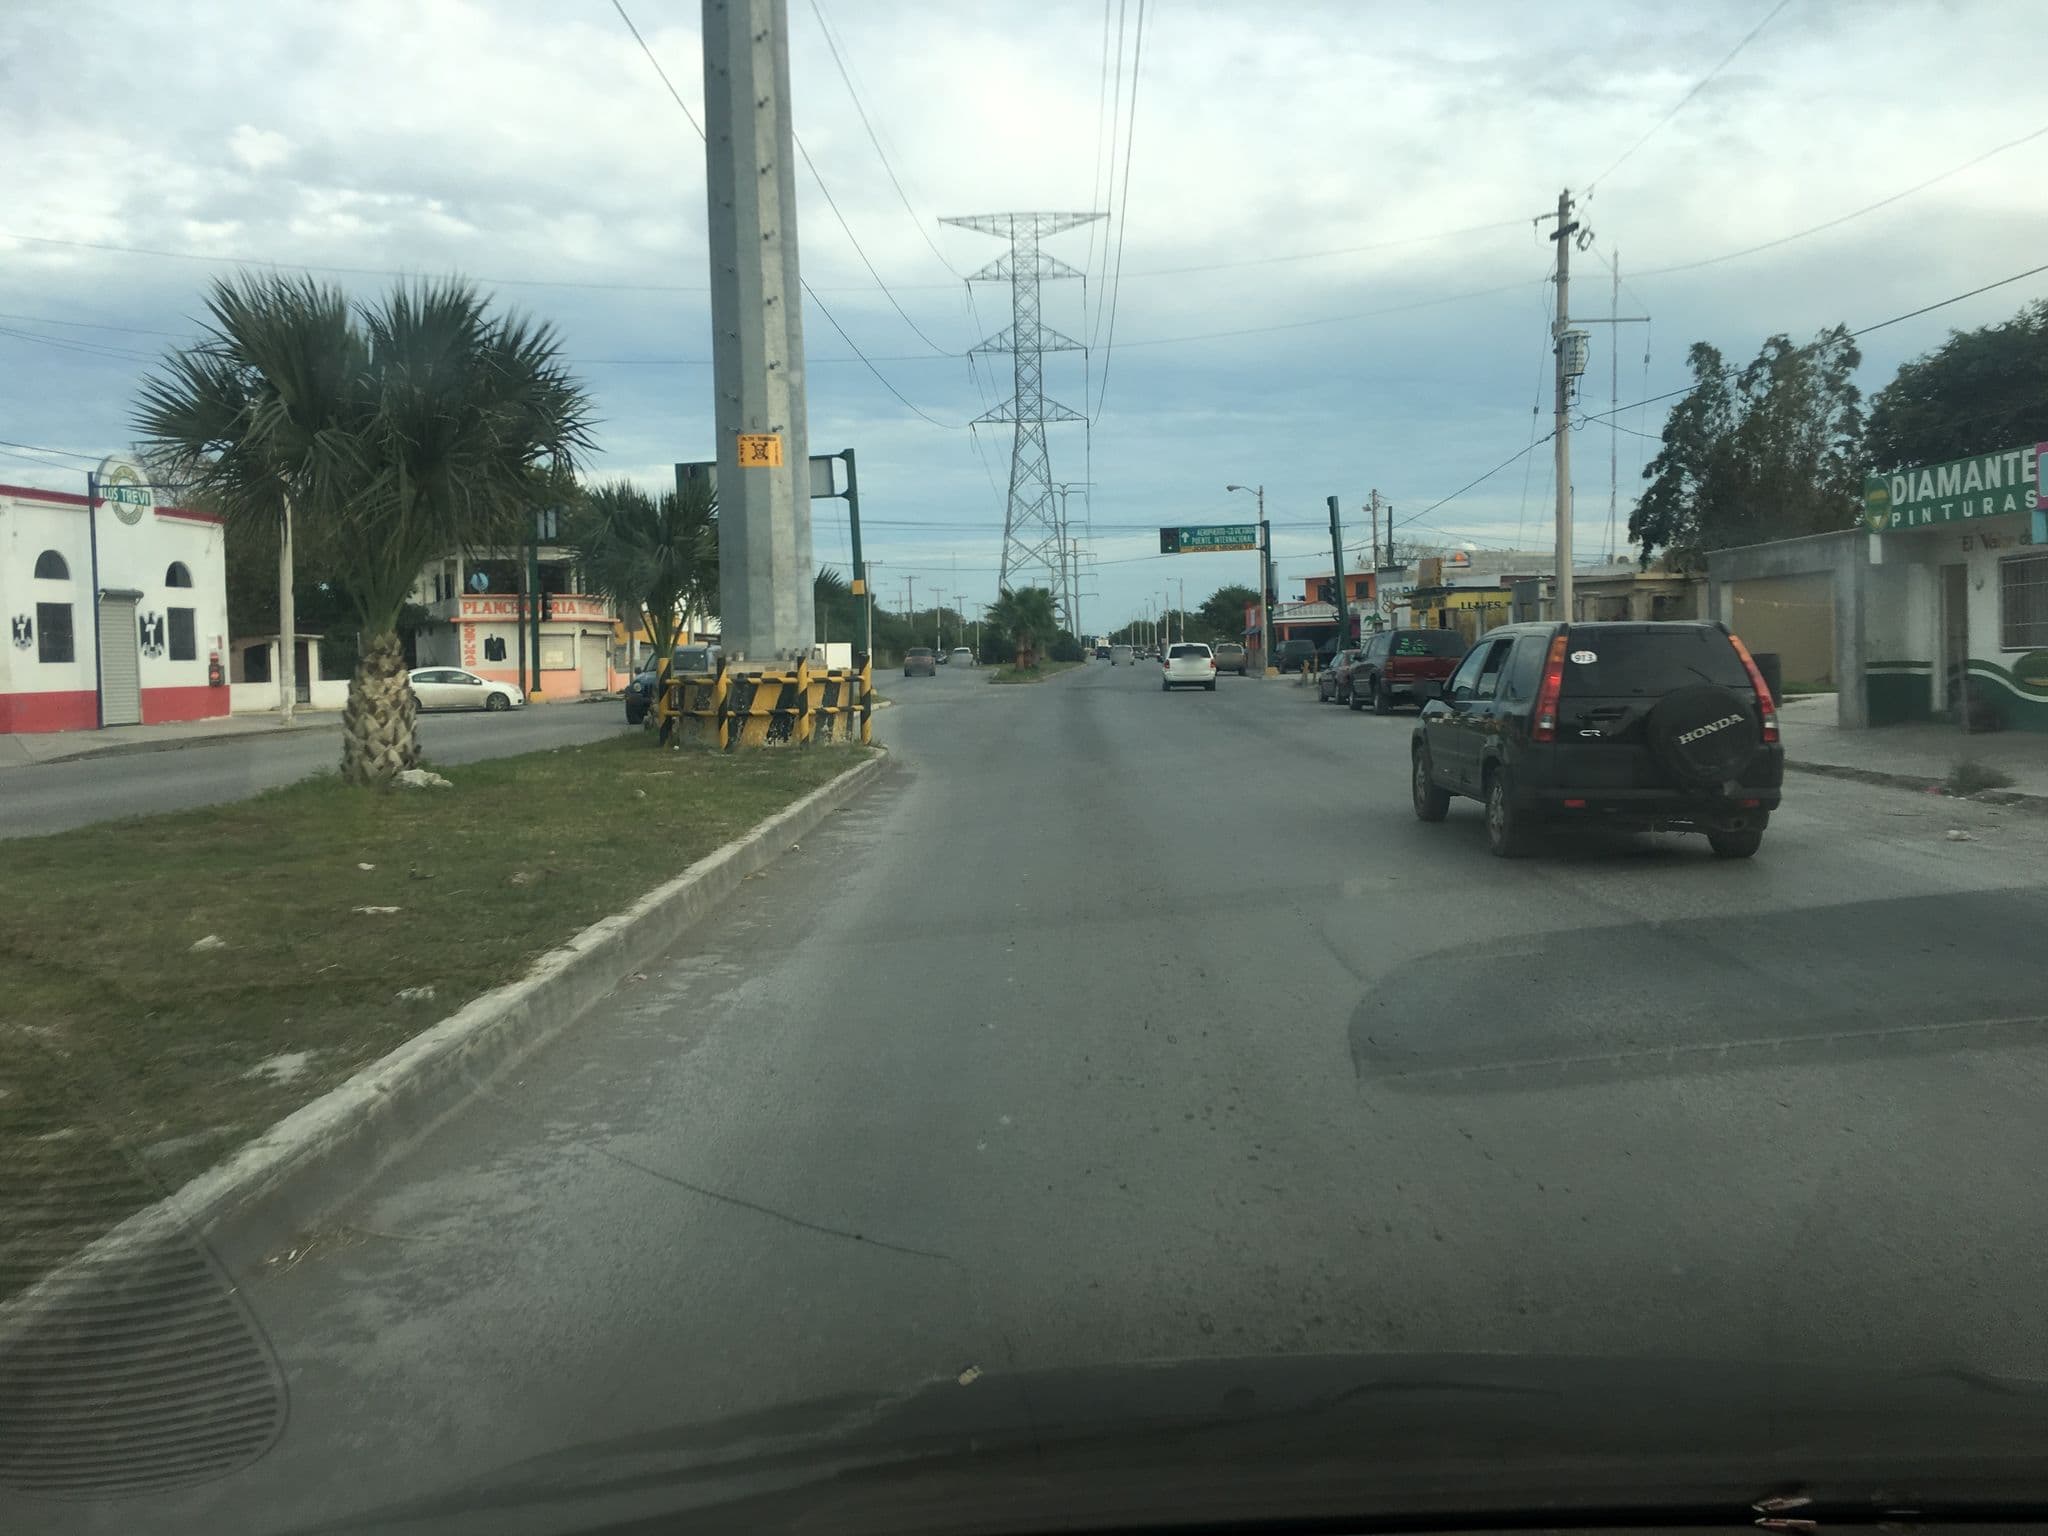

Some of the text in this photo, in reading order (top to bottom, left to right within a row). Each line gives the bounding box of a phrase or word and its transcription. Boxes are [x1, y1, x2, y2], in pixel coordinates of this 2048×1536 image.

[1892, 448, 2037, 506] DIAMANTE
[103, 487, 119, 501] LOS
[1892, 489, 2039, 528] PINTURAS
[463, 600, 577, 614] PLANCHARIA
[1678, 713, 1745, 745] HONDA
